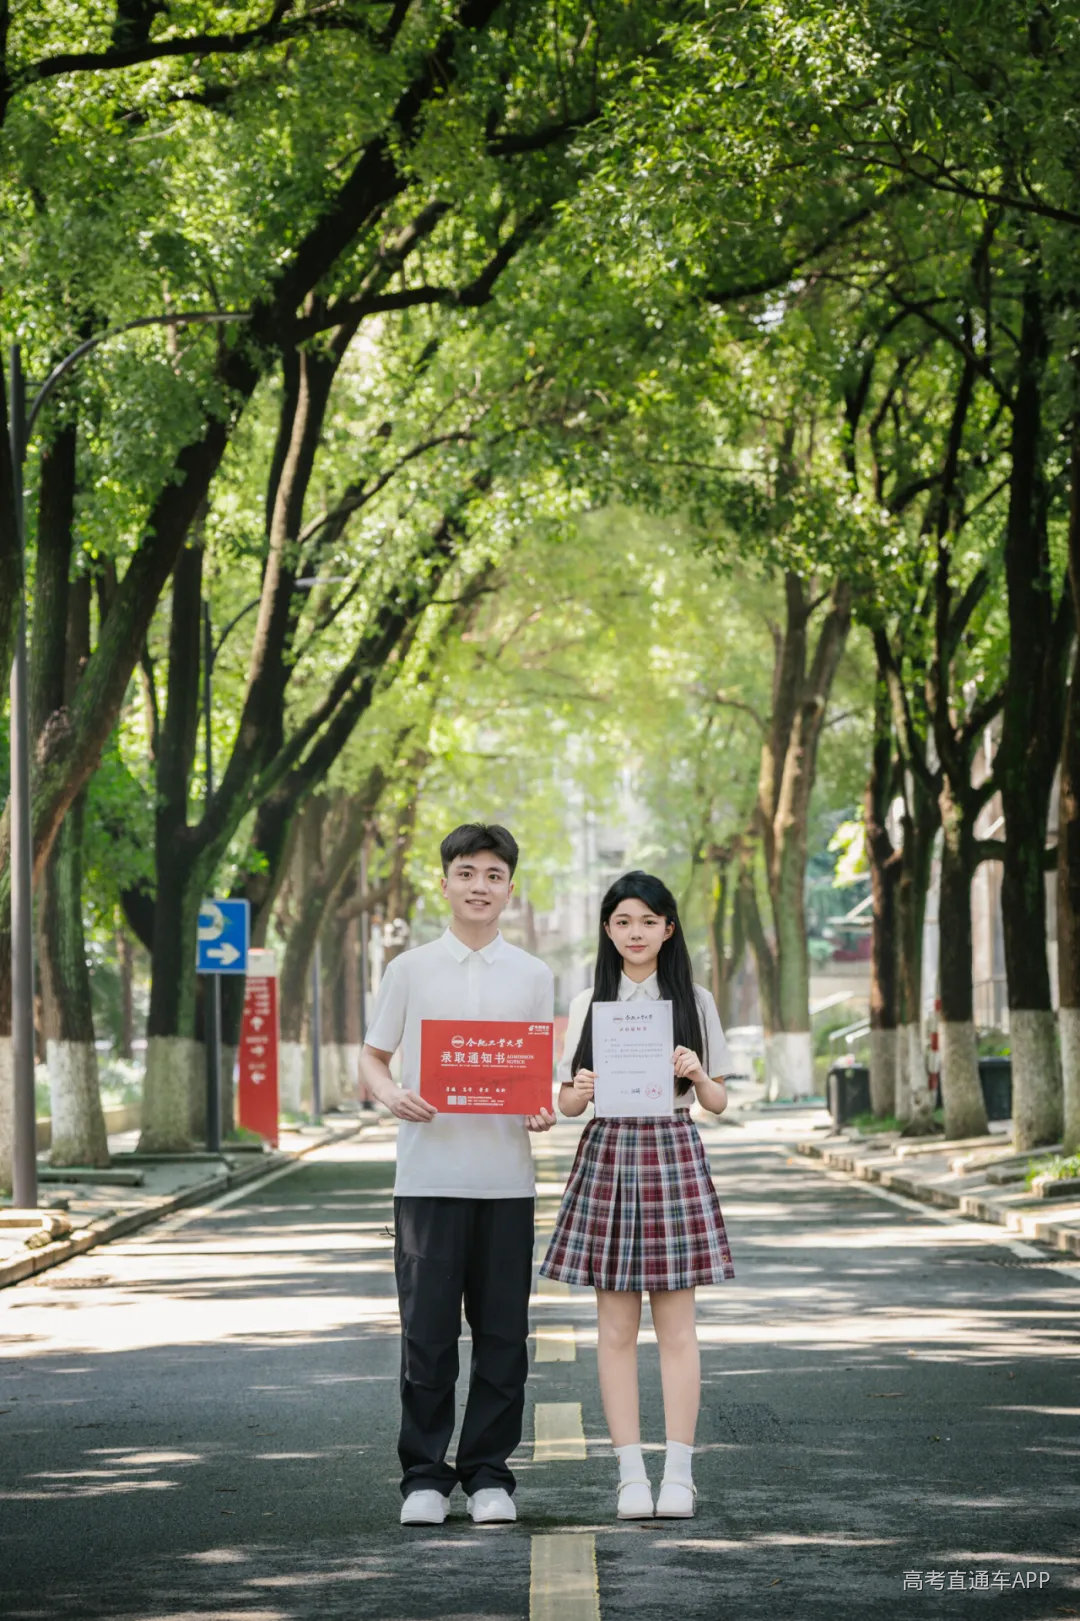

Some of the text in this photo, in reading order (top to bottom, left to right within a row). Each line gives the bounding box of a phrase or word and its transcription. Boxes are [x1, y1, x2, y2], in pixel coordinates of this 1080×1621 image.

[441, 1051, 506, 1064] 录取通知书
